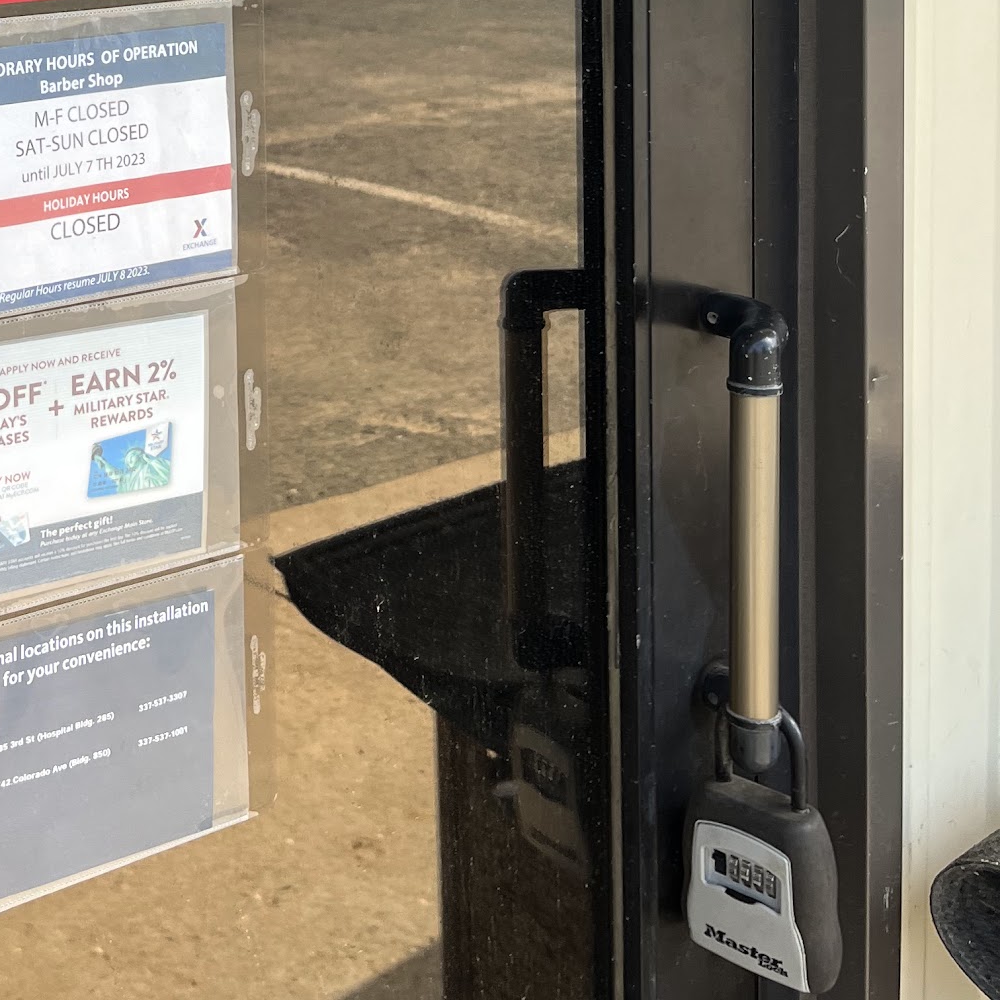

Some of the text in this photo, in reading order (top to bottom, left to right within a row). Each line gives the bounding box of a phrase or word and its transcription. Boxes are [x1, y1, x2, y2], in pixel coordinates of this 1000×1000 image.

[46, 51, 95, 72] HOURS
[101, 50, 120, 65] OF
[123, 40, 198, 62] OPERATION
[40, 72, 124, 95] Barber Shop
[34, 100, 130, 128] M-F CLOSED
[16, 123, 149, 158] SAT-SUN CLOSED
[21, 152, 146, 184] until JULY 7 TH 2023
[43, 188, 130, 212] HOLIDAY HOURS
[50, 212, 120, 241] CLOSED
[182, 238, 217, 251] EXCHANGE
[36, 282, 62, 297] Hours
[64, 277, 96, 290] resume
[96, 270, 118, 285] JULY
[120, 269, 126, 281] 8
[0, 348, 121, 376] APPLY NOW AND RECEIVE
[71, 358, 177, 396] EARN 2%
[74, 394, 134, 416] MILITARY
[91, 406, 154, 429] REWARDS
[4, 471, 32, 485] NOW
[11, 482, 28, 490] CODE
[40, 516, 114, 538] The perfect gift!
[20, 632, 84, 660] locations
[86, 627, 104, 644] on
[106, 617, 132, 638] this
[134, 600, 209, 628] installation
[2, 636, 152, 687] for your convenience:
[10, 738, 24, 749] 3rd
[26, 735, 35, 744] St
[37, 724, 74, 742] (Hospital
[75, 718, 95, 730] Bldg.
[12, 768, 50, 784] Colorado
[52, 762, 68, 774] Ave
[68, 755, 91, 769] (Bldg.
[704, 923, 784, 968] Master
[758, 959, 789, 978] Lock
